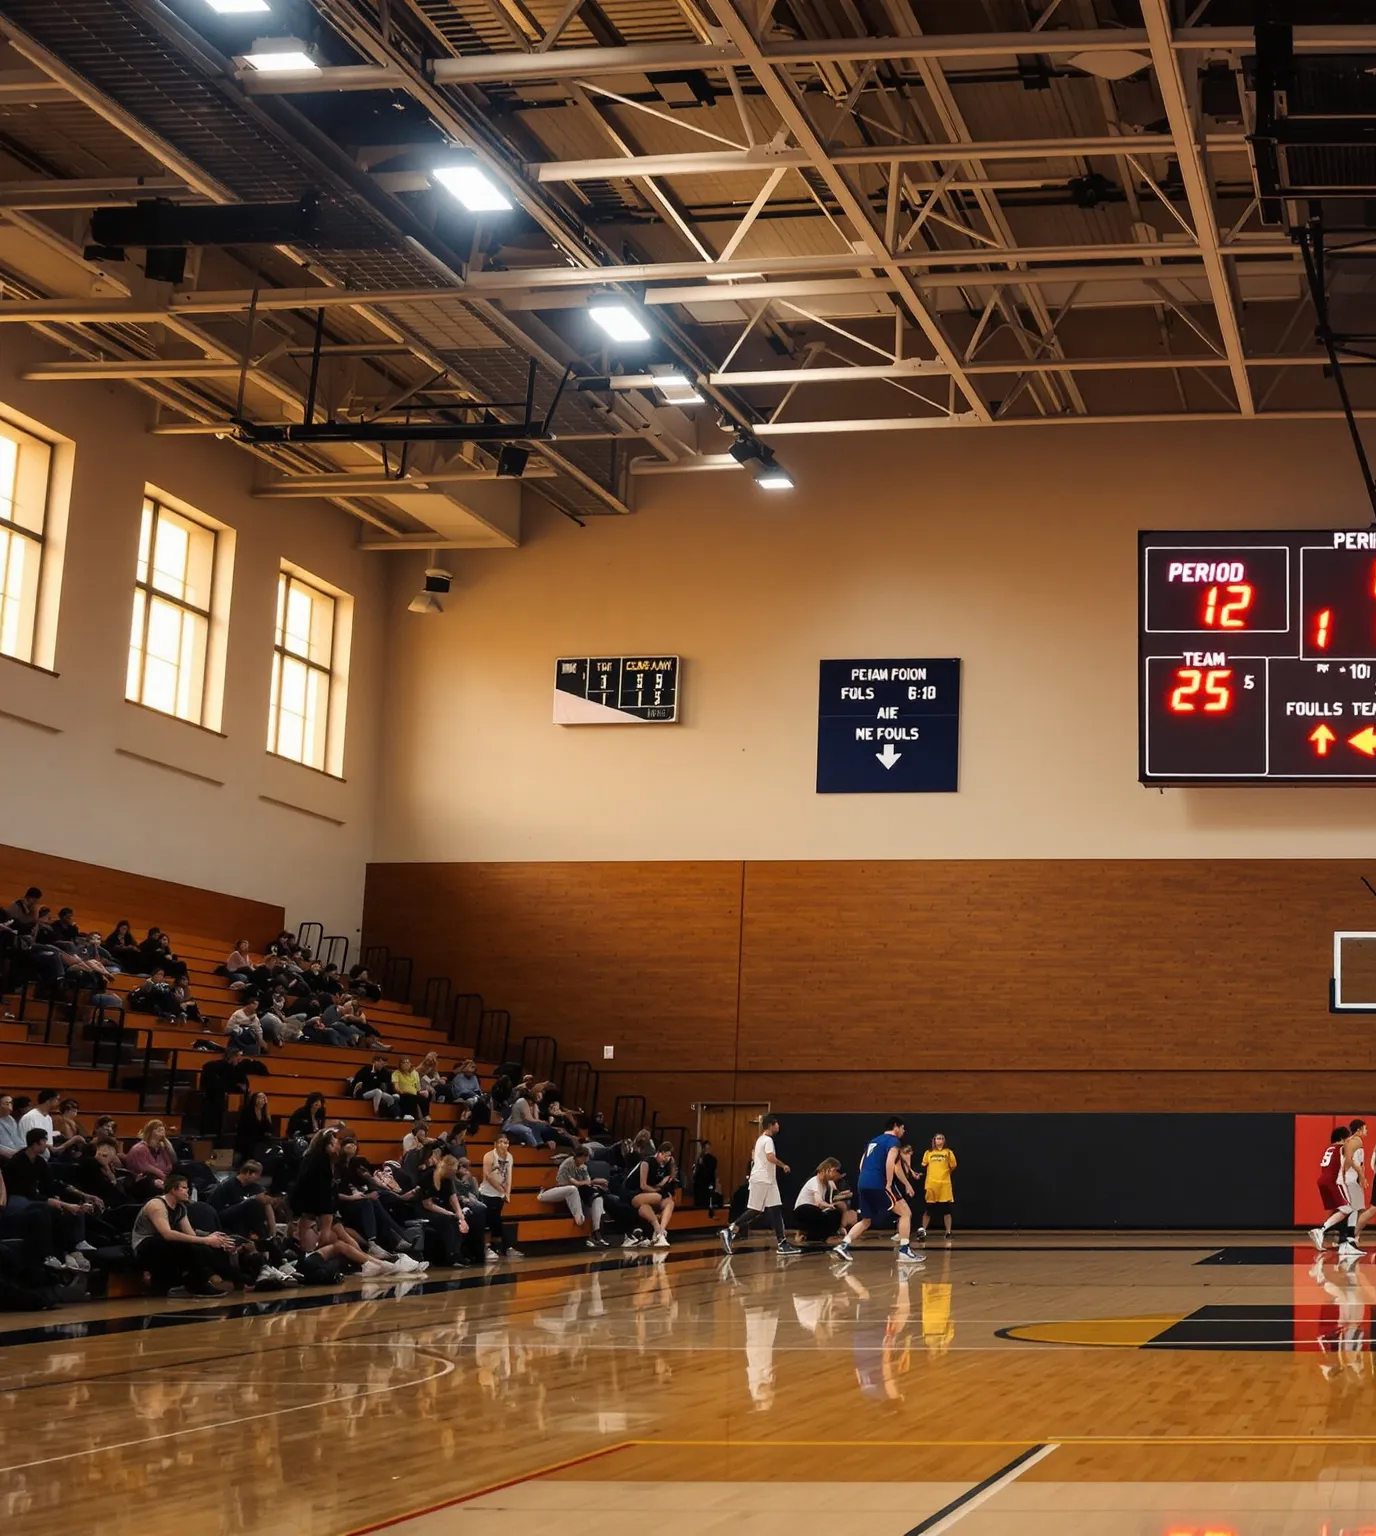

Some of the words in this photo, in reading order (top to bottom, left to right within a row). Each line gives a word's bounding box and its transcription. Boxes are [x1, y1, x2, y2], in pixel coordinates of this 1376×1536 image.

[1168, 562, 1245, 582] PERIOD
[1205, 585, 1252, 627] 12
[1317, 610, 1330, 648] 1
[1183, 652, 1225, 666] TEAM
[1171, 670, 1232, 710] 25
[1244, 675, 1255, 689] 5
[1286, 702, 1343, 716] FOULLS
[855, 728, 873, 740] NE
[877, 728, 919, 740] FOULS
